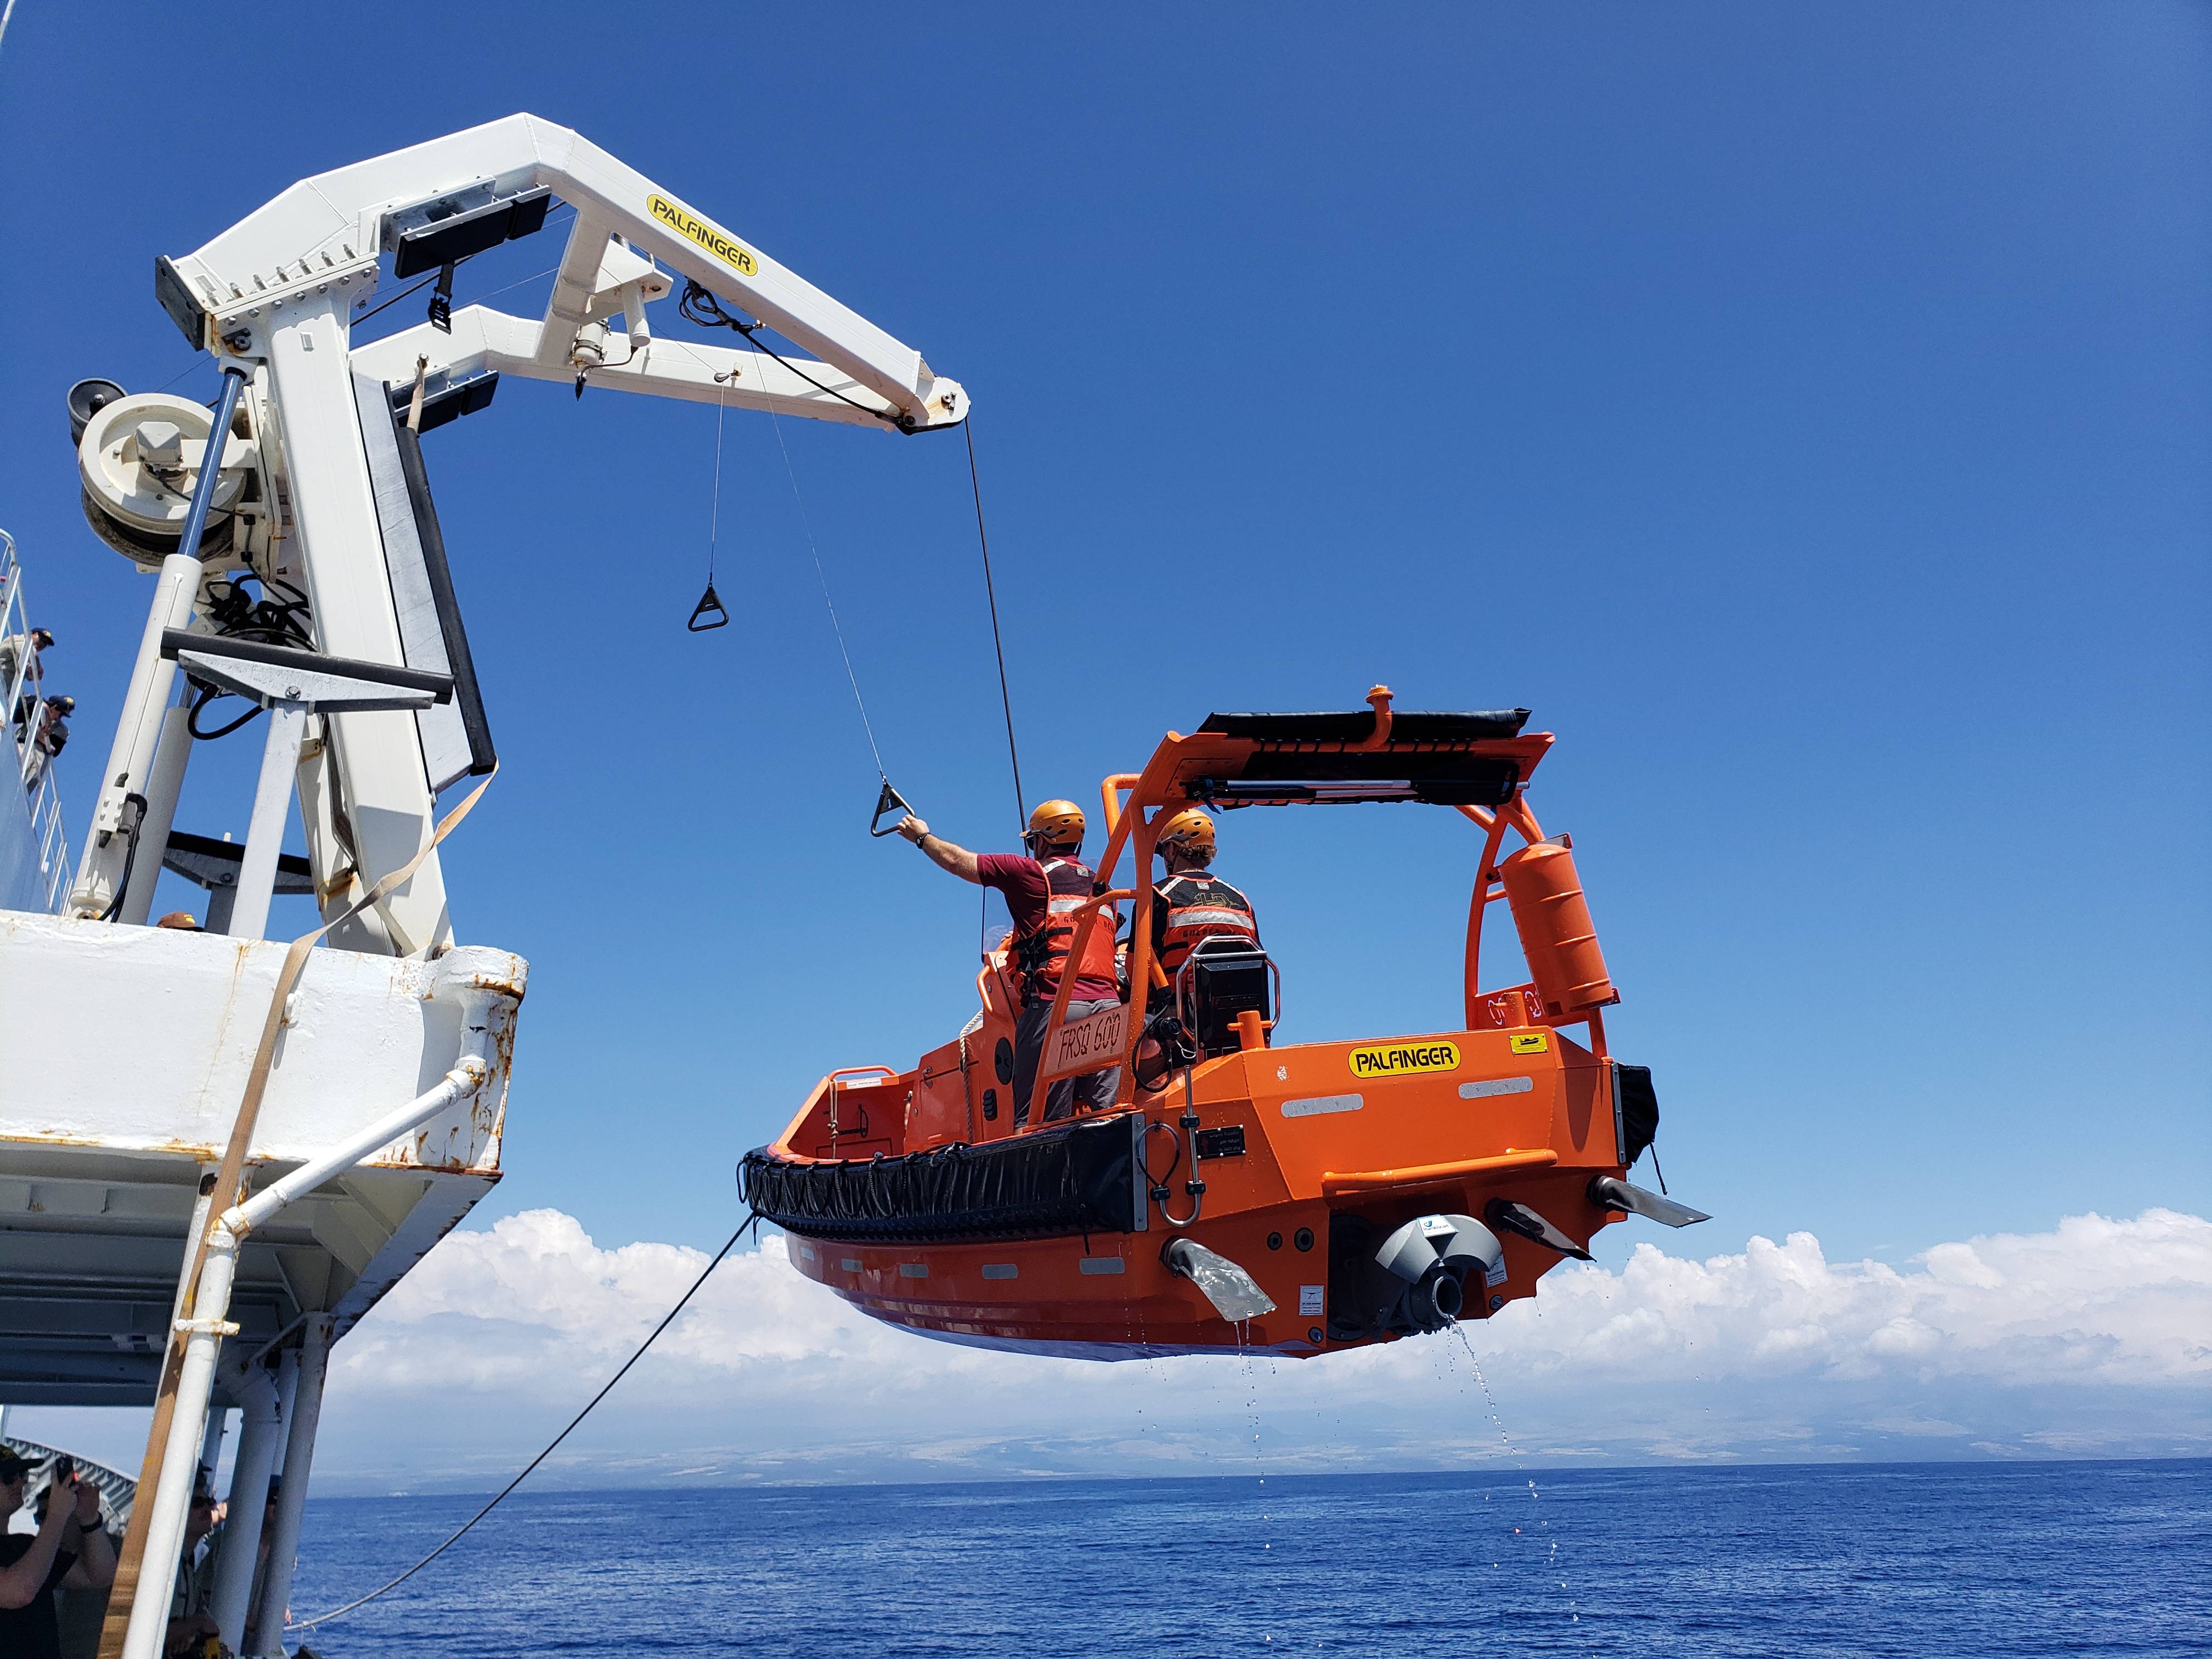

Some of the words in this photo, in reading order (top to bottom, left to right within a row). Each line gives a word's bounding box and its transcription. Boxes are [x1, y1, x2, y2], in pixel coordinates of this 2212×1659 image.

[653, 199, 751, 272] PALFINGER
[1059, 1023, 1091, 1063] FRSQ
[1094, 1013, 1120, 1051] 600
[1356, 1047, 1454, 1071] PALFINGER
